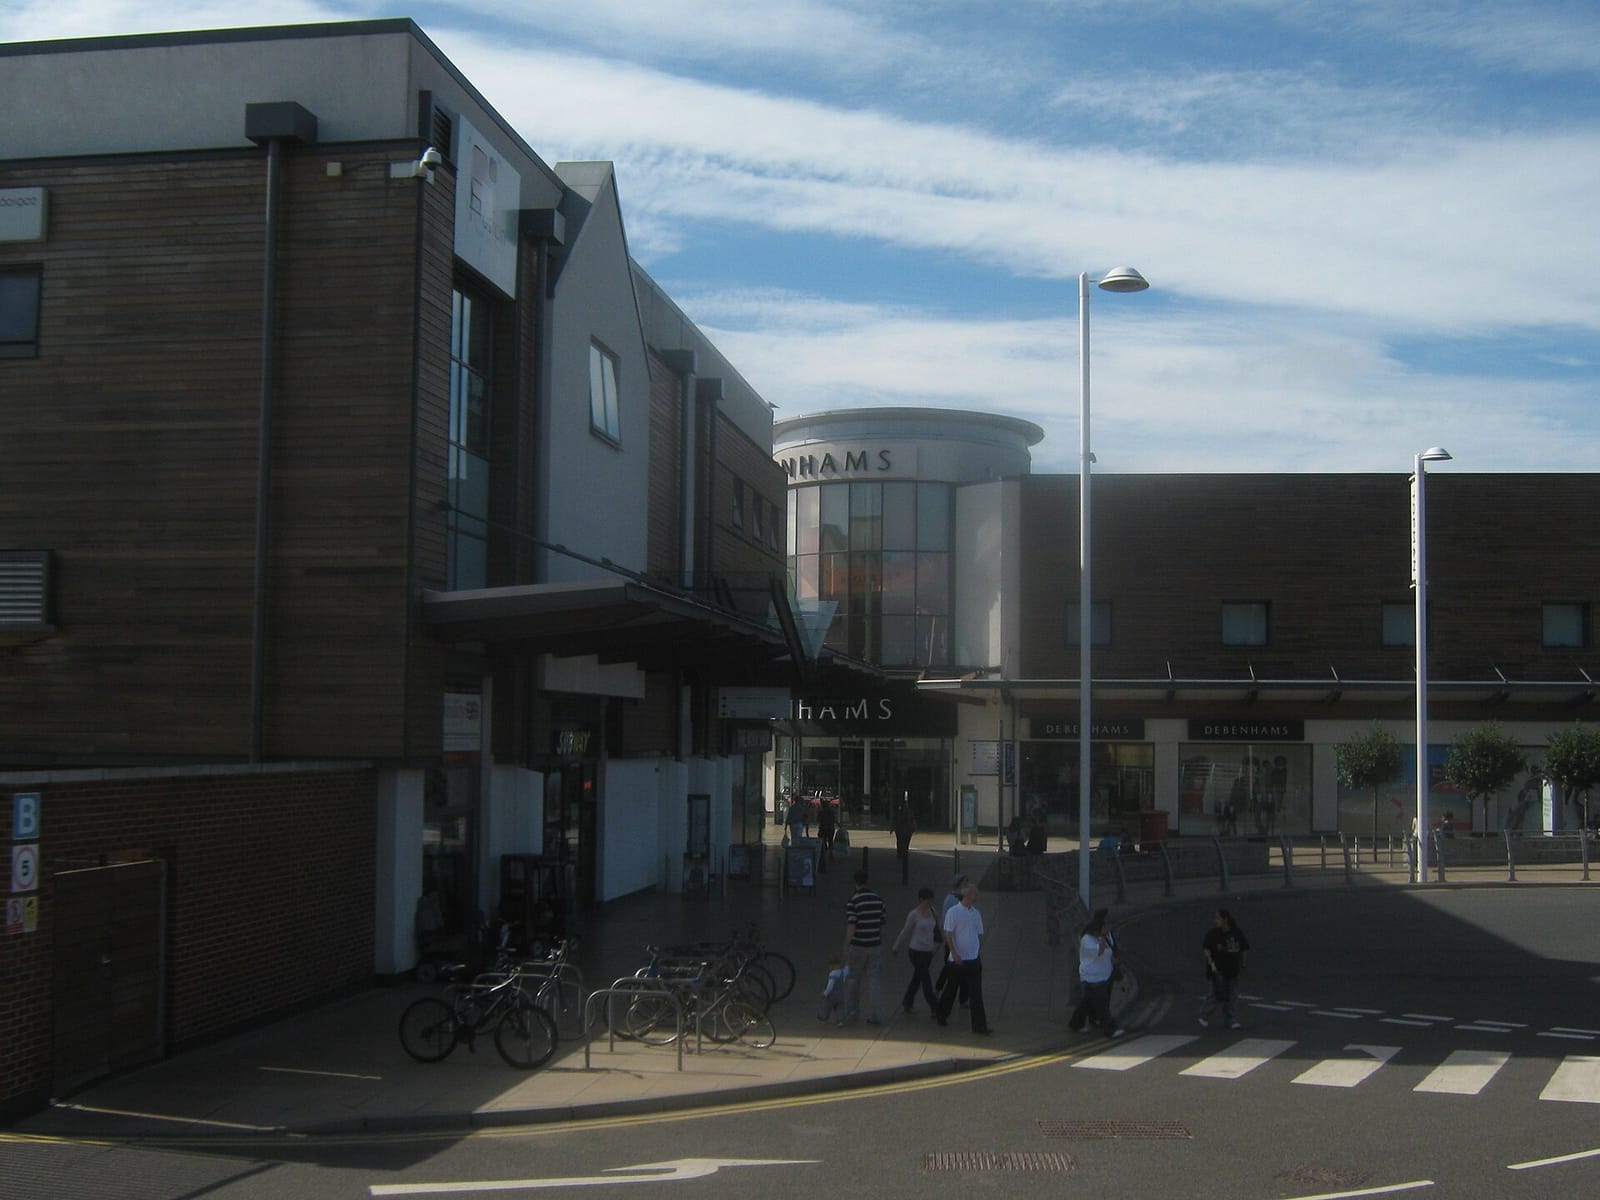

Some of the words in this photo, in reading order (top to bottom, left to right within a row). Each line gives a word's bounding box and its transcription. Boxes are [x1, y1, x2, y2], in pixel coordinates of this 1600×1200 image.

[789, 698, 892, 720] HAMS
[1046, 725, 1129, 735] DEBEHAMS
[1204, 725, 1289, 735] DEBENHAMS
[18, 798, 36, 834] B
[21, 860, 30, 877] 5
